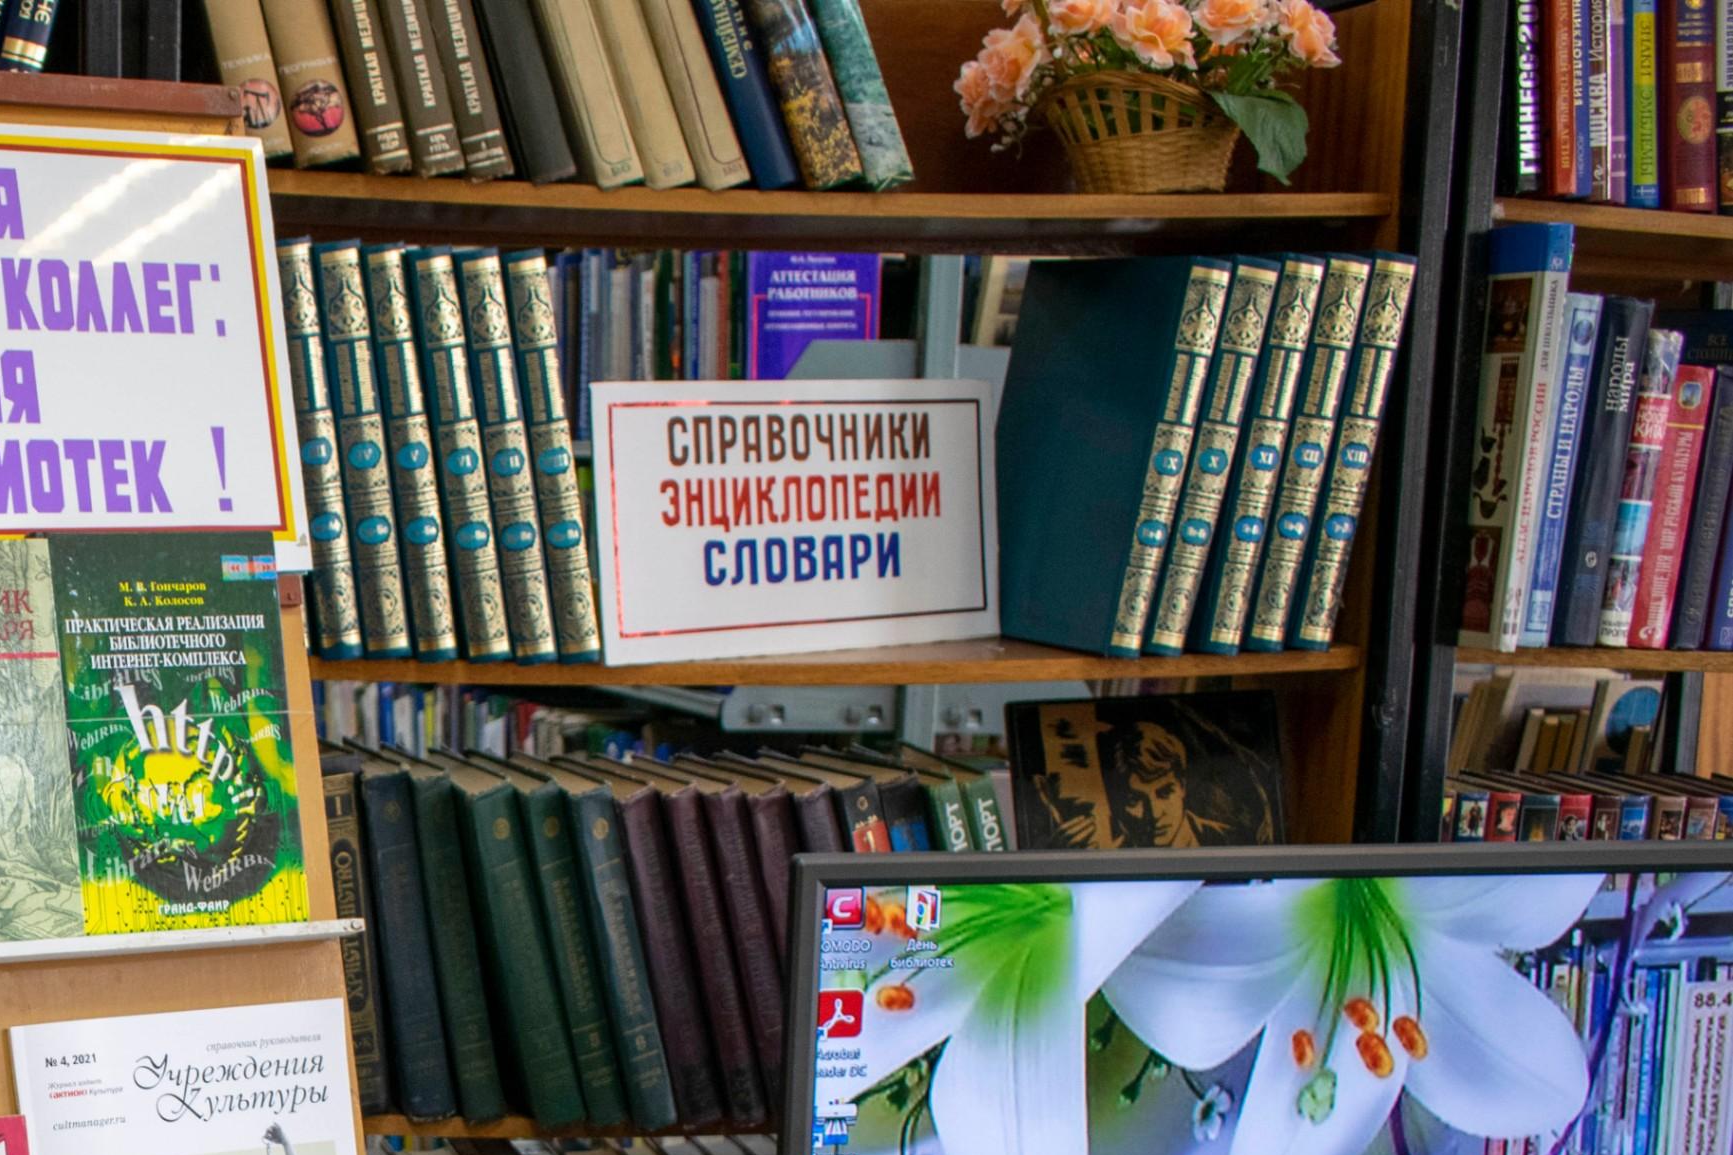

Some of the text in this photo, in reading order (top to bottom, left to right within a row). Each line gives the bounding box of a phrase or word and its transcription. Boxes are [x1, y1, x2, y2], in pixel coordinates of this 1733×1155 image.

[363, 52, 387, 106] КРАТКАЯ
[414, 54, 436, 108] КРАТКАЯ
[459, 61, 482, 115] КРАТКАЯ
[770, 269, 857, 284] АТТЕСТАЦИЯ
[767, 287, 858, 301] РАБОТНИКОВ
[1530, 382, 1548, 444] РОССИИ
[667, 411, 931, 468] СПРАВОЧНИКИ
[1547, 365, 1585, 519] СТРАНЫ И НАРОДЫ
[659, 471, 942, 534] ЭНЦИКЛОПЕДИИ
[704, 532, 901, 589] СЛОВАРИ
[119, 581, 206, 594] М. Гончаров
[124, 595, 204, 607] К. Колосов
[65, 614, 265, 634] ПРАКТИЧЕСКАЯ РЕАЛИЗАЦИЯ
[109, 632, 226, 651] БИБЛИОТЕЧНОГО
[91, 651, 247, 670] ИНТЕРНЕТ-КОМПЛЕКСА
[906, 938, 938, 952] День
[889, 957, 954, 969] библиотек
[72, 1054, 96, 1066] 2021
[132, 1053, 325, 1098] Учреждения
[156, 1084, 329, 1122] Культуры
[53, 1115, 127, 1131] cultmanager.ru
